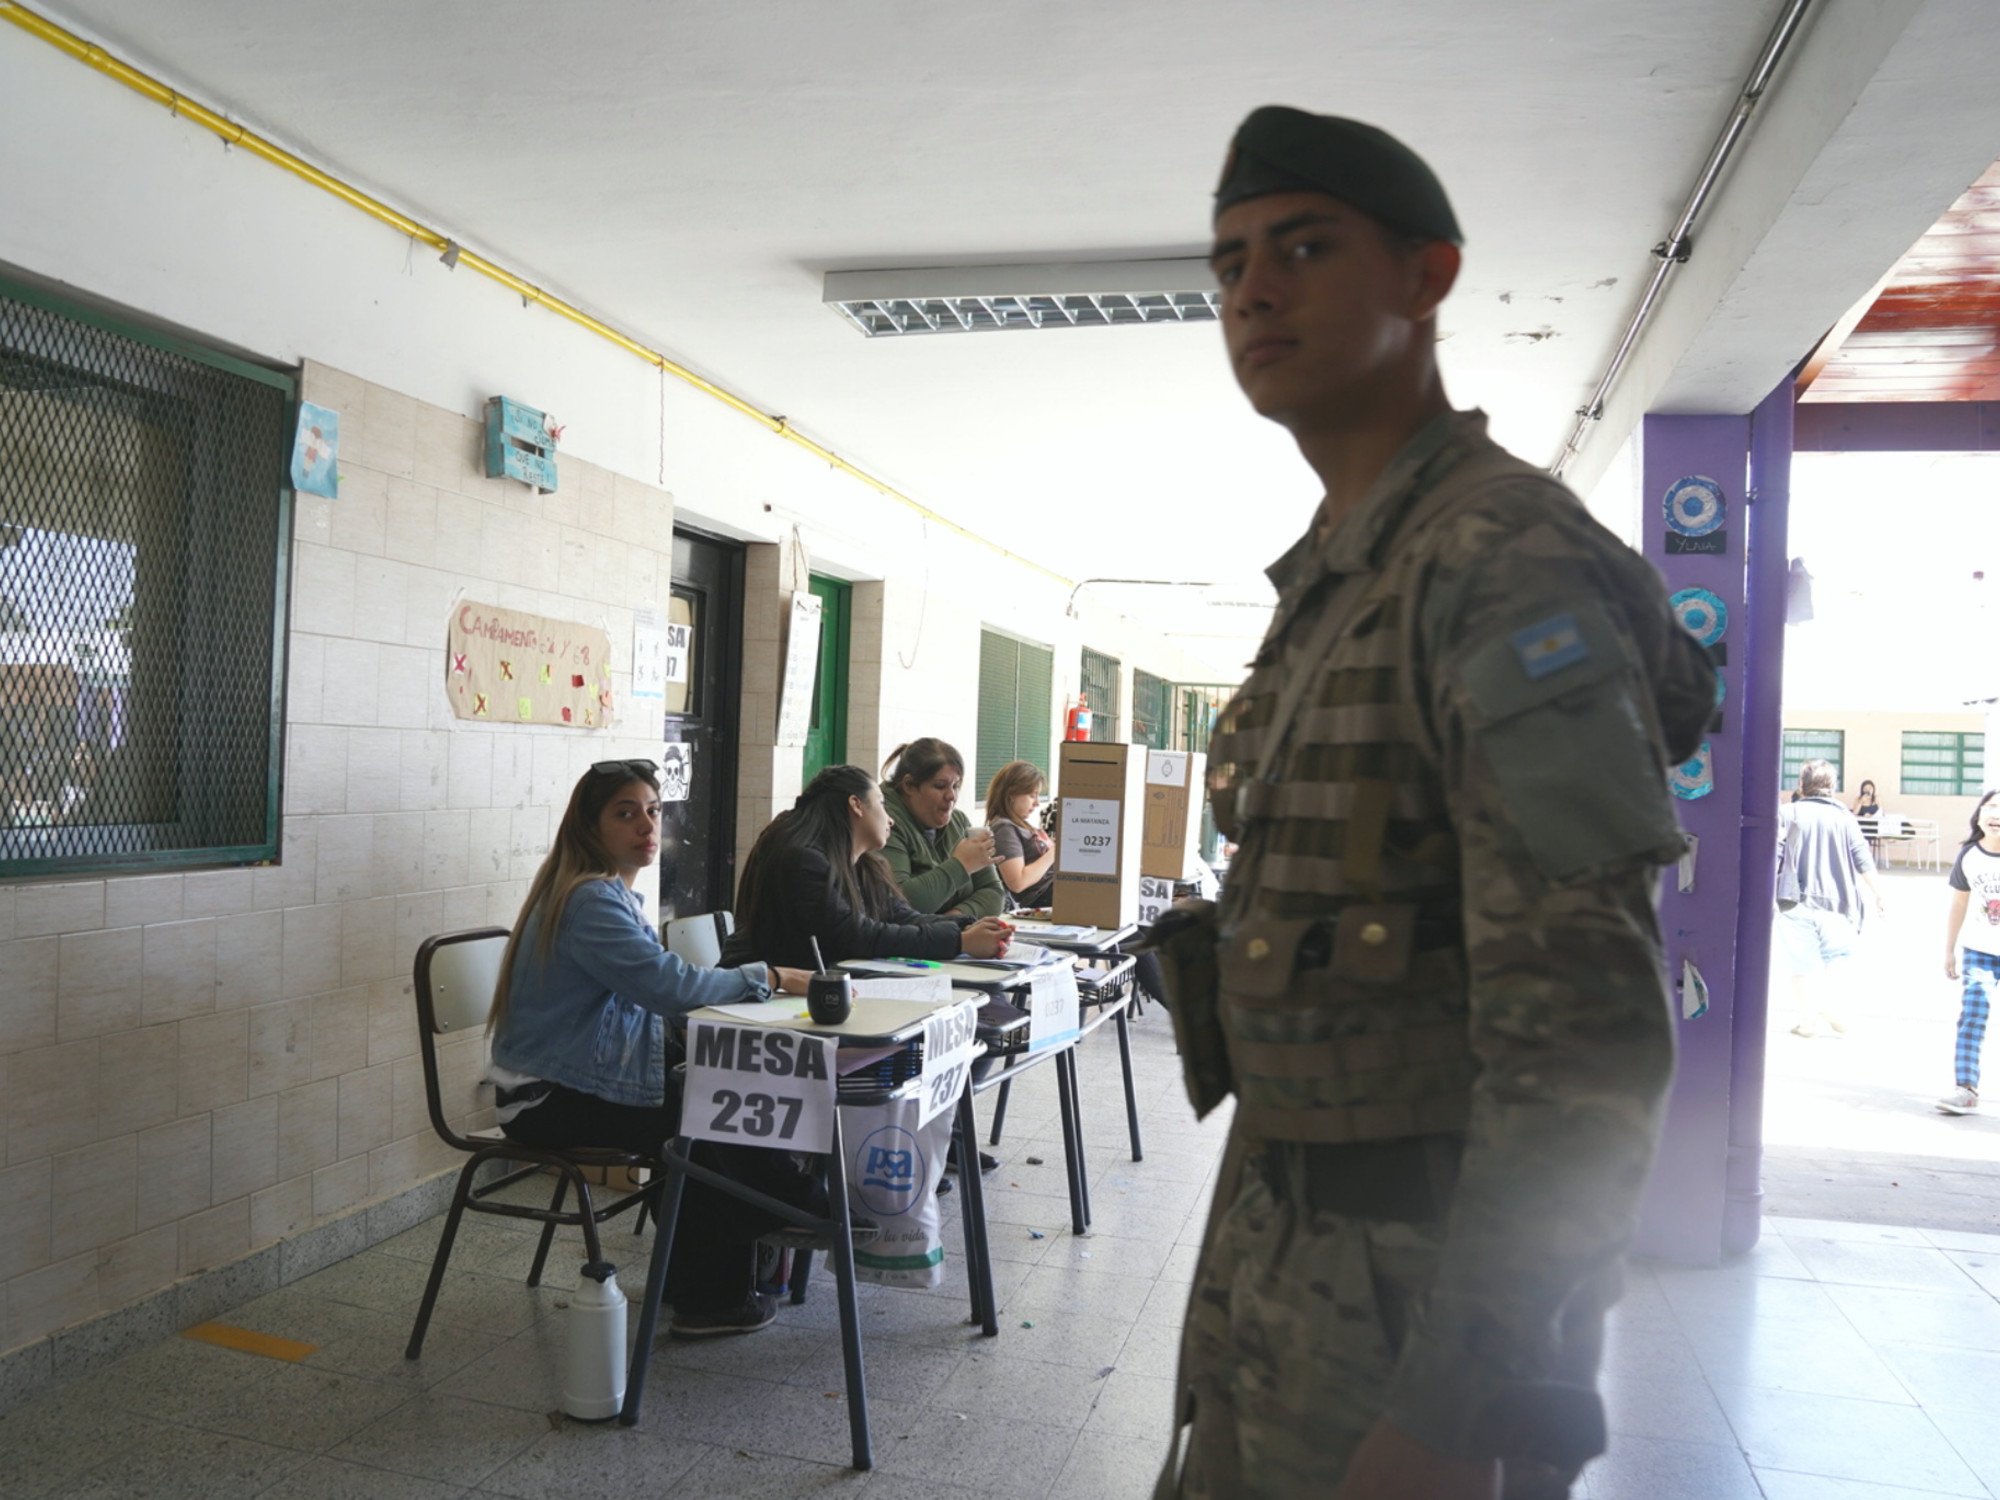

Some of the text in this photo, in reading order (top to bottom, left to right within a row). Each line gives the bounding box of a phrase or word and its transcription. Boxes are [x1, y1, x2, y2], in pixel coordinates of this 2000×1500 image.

[1083, 835, 1111, 847] 0237
[694, 1024, 829, 1081] MESA
[928, 1004, 975, 1062] MESA
[929, 1061, 965, 1113] 237
[709, 1089, 804, 1140] 237
